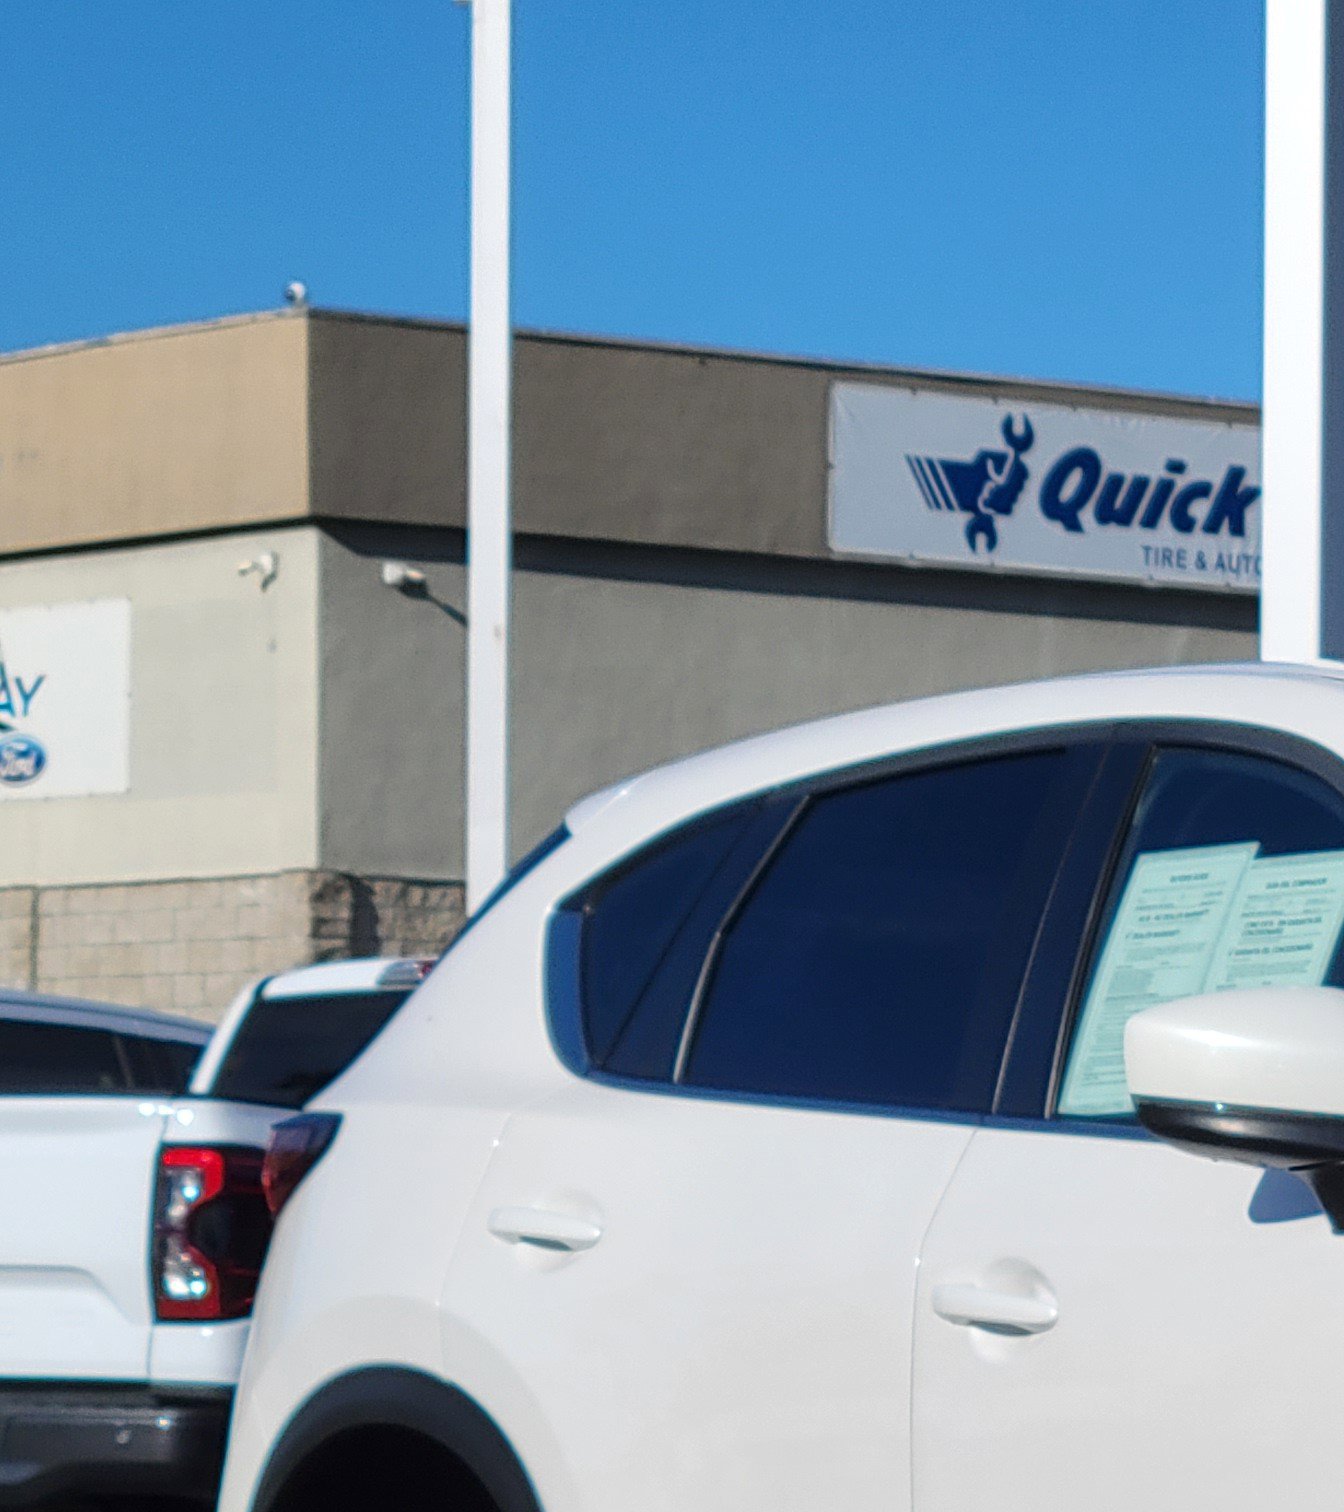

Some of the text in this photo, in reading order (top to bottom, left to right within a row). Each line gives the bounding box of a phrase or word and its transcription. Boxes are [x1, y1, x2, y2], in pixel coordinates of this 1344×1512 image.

[1038, 446, 1262, 537] Quick
[1141, 545, 1188, 571] TIRE
[1194, 550, 1207, 571] &
